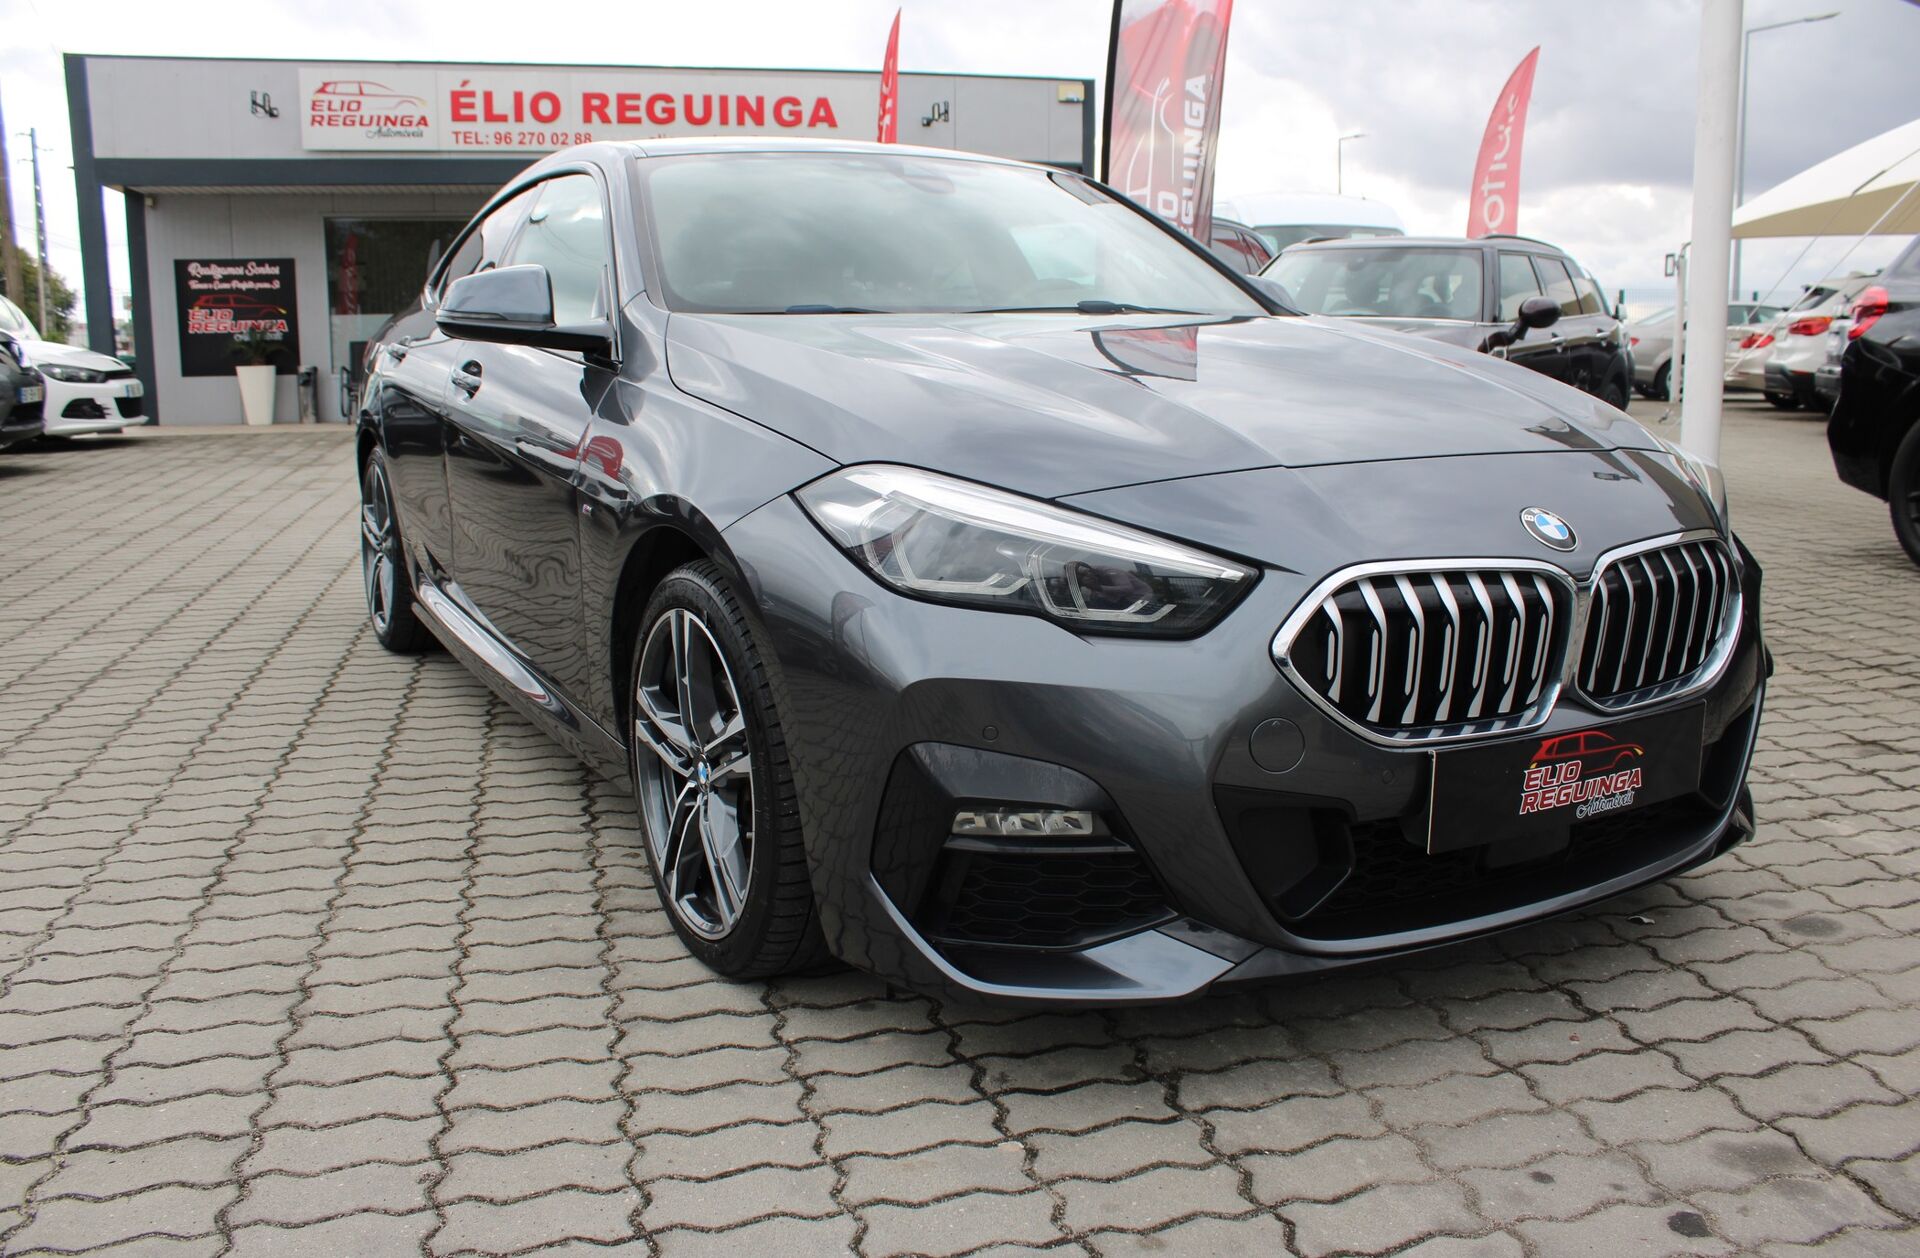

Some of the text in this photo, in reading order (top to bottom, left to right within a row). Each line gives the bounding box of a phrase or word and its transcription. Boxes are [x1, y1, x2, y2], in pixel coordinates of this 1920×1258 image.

[311, 100, 362, 112] ELIO
[450, 80, 561, 123] ÉLIO
[582, 92, 838, 127] REGUINGA
[310, 115, 429, 127] REGUINGA
[452, 131, 592, 145] TEL: 96 270 02 88
[1523, 760, 1582, 791] ELIO
[1520, 767, 1642, 815] REGUINGA
